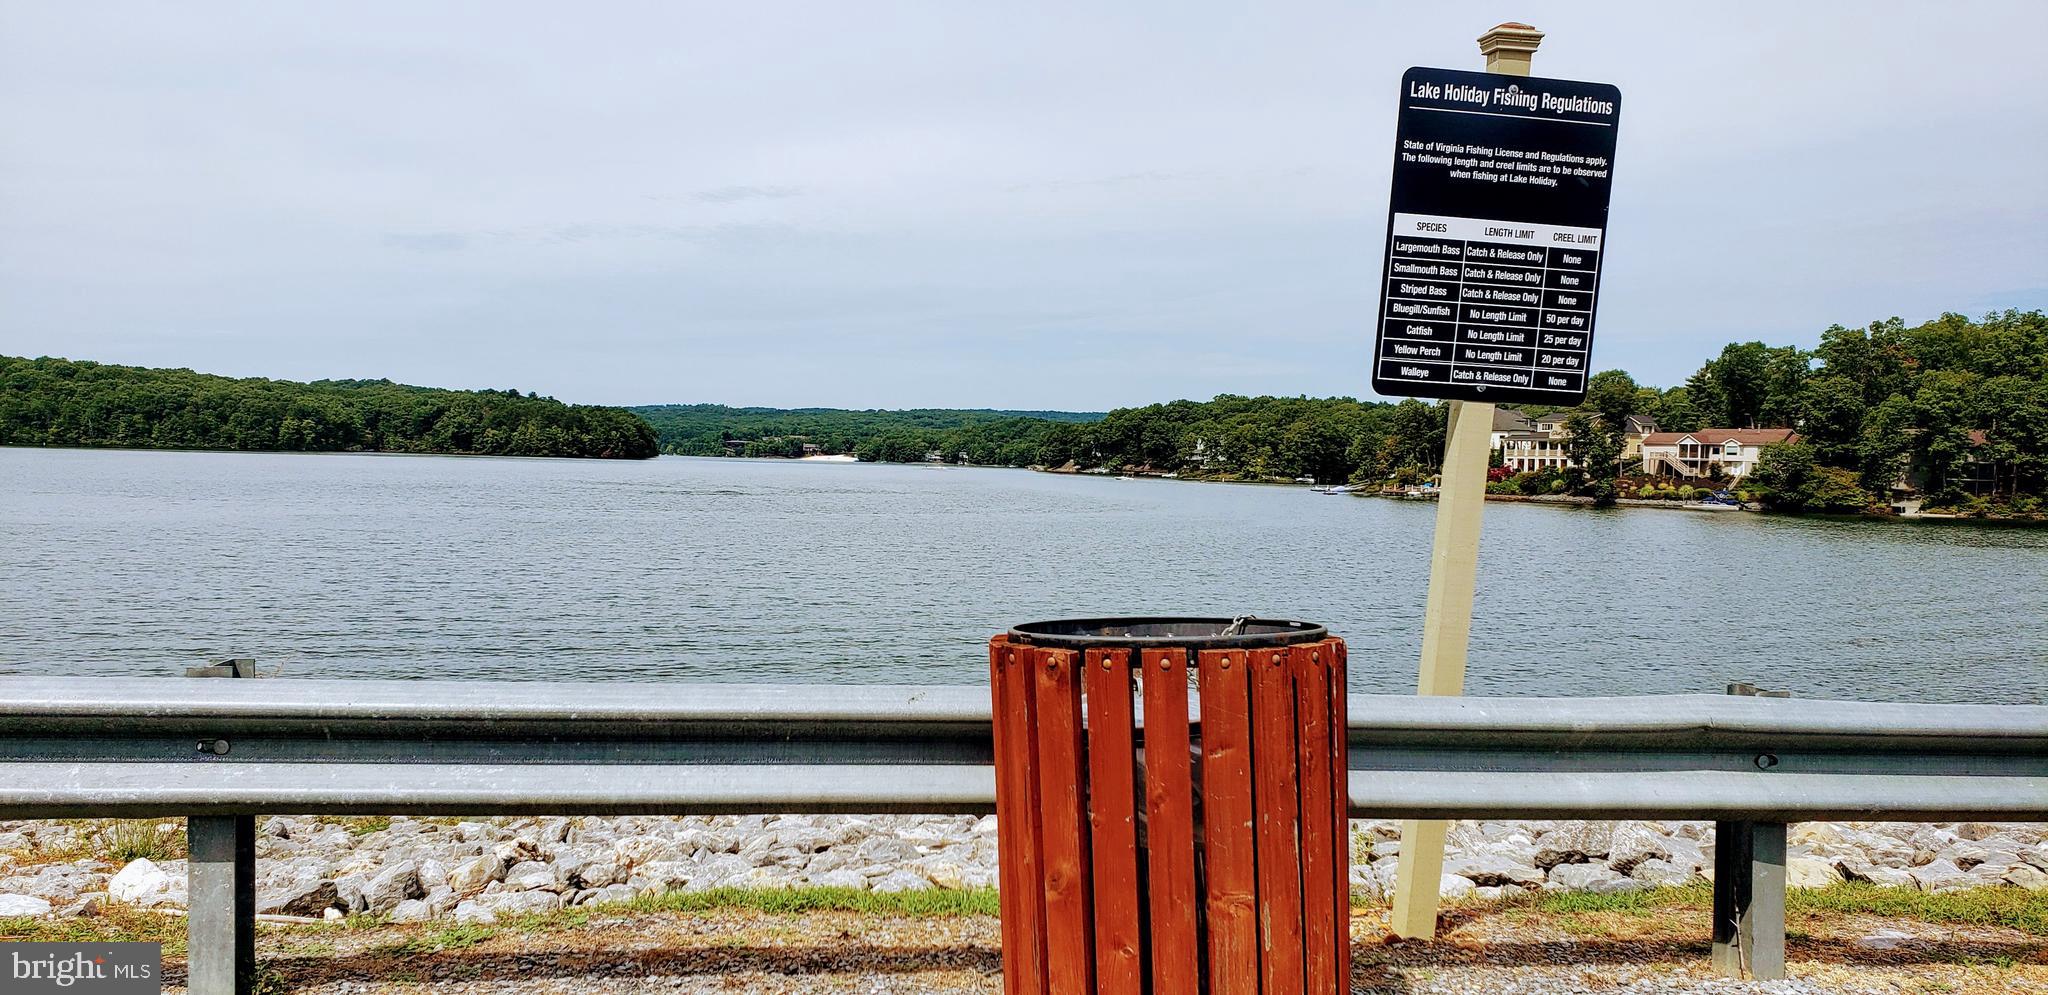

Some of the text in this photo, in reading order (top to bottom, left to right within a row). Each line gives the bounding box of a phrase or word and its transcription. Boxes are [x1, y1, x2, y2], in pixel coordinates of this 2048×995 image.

[1410, 81, 1613, 115] Lake Holiday Fishing Regulations
[1404, 140, 1608, 167] State of Virginia Fishing License and Regulations apply.
[1402, 153, 1608, 178] The following length and creel limits are to be observed
[1450, 170, 1558, 187] when fishing at Lake Holiday.
[1417, 222, 1447, 232] SPECIES
[1484, 227, 1535, 239] LENGTH LIMIT
[1553, 233, 1597, 244] CREEL LIMIT
[1396, 242, 1461, 255] Largemouth Bass
[1467, 247, 1543, 263] Catch & Release Only
[1563, 254, 1582, 264] None
[1393, 263, 1458, 276] Smallmouth Bass
[1464, 267, 1541, 284] Catch & Release Only
[1560, 275, 1579, 286] None
[1400, 283, 1447, 296] Striped Bass
[1462, 288, 1539, 304] Catch & Release Only
[1558, 295, 1577, 305] None
[1393, 303, 1450, 316] Bluegill/Sunfish
[1469, 309, 1527, 322] No Length Limit
[1546, 315, 1584, 327] 50 per day
[1406, 325, 1433, 336] Catfish
[1467, 329, 1525, 342] No Length Limit
[1543, 335, 1582, 347] 25 per day
[1394, 345, 1441, 356] Yellow Perch
[1465, 349, 1523, 362] No Length Limit
[1541, 355, 1580, 367] 20 per day
[1401, 366, 1429, 378] Walleye
[1453, 370, 1474, 380] Catch
[1483, 373, 1512, 383] Release
[1513, 373, 1529, 385] Only
[1548, 376, 1567, 386] None
